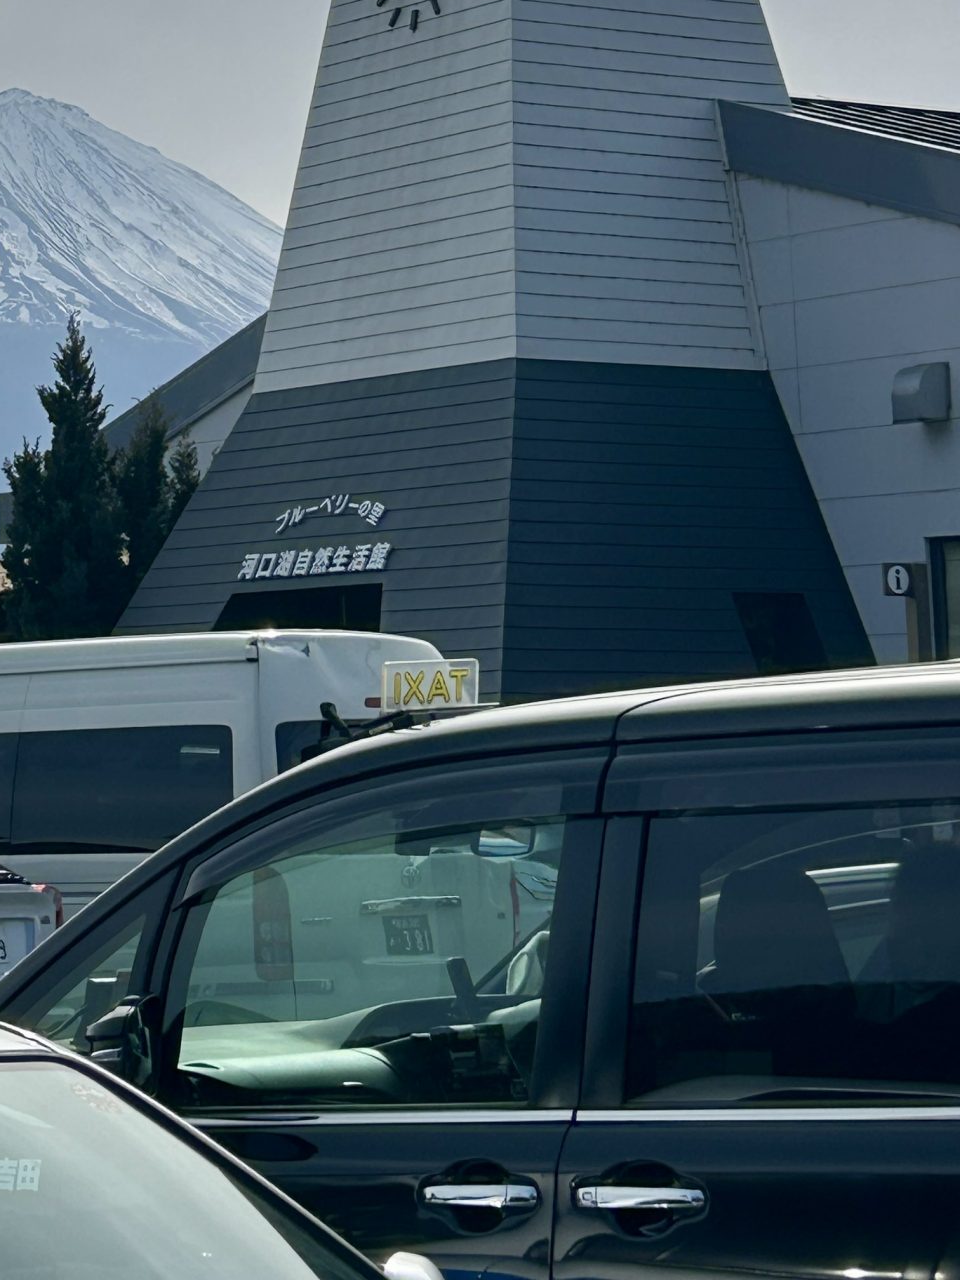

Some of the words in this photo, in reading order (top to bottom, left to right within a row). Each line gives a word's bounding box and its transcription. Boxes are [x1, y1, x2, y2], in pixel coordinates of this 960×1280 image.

[274, 494, 386, 535] ブルーベリーの里
[237, 542, 391, 580] 河口湖自然生活館
[894, 568, 903, 591] i
